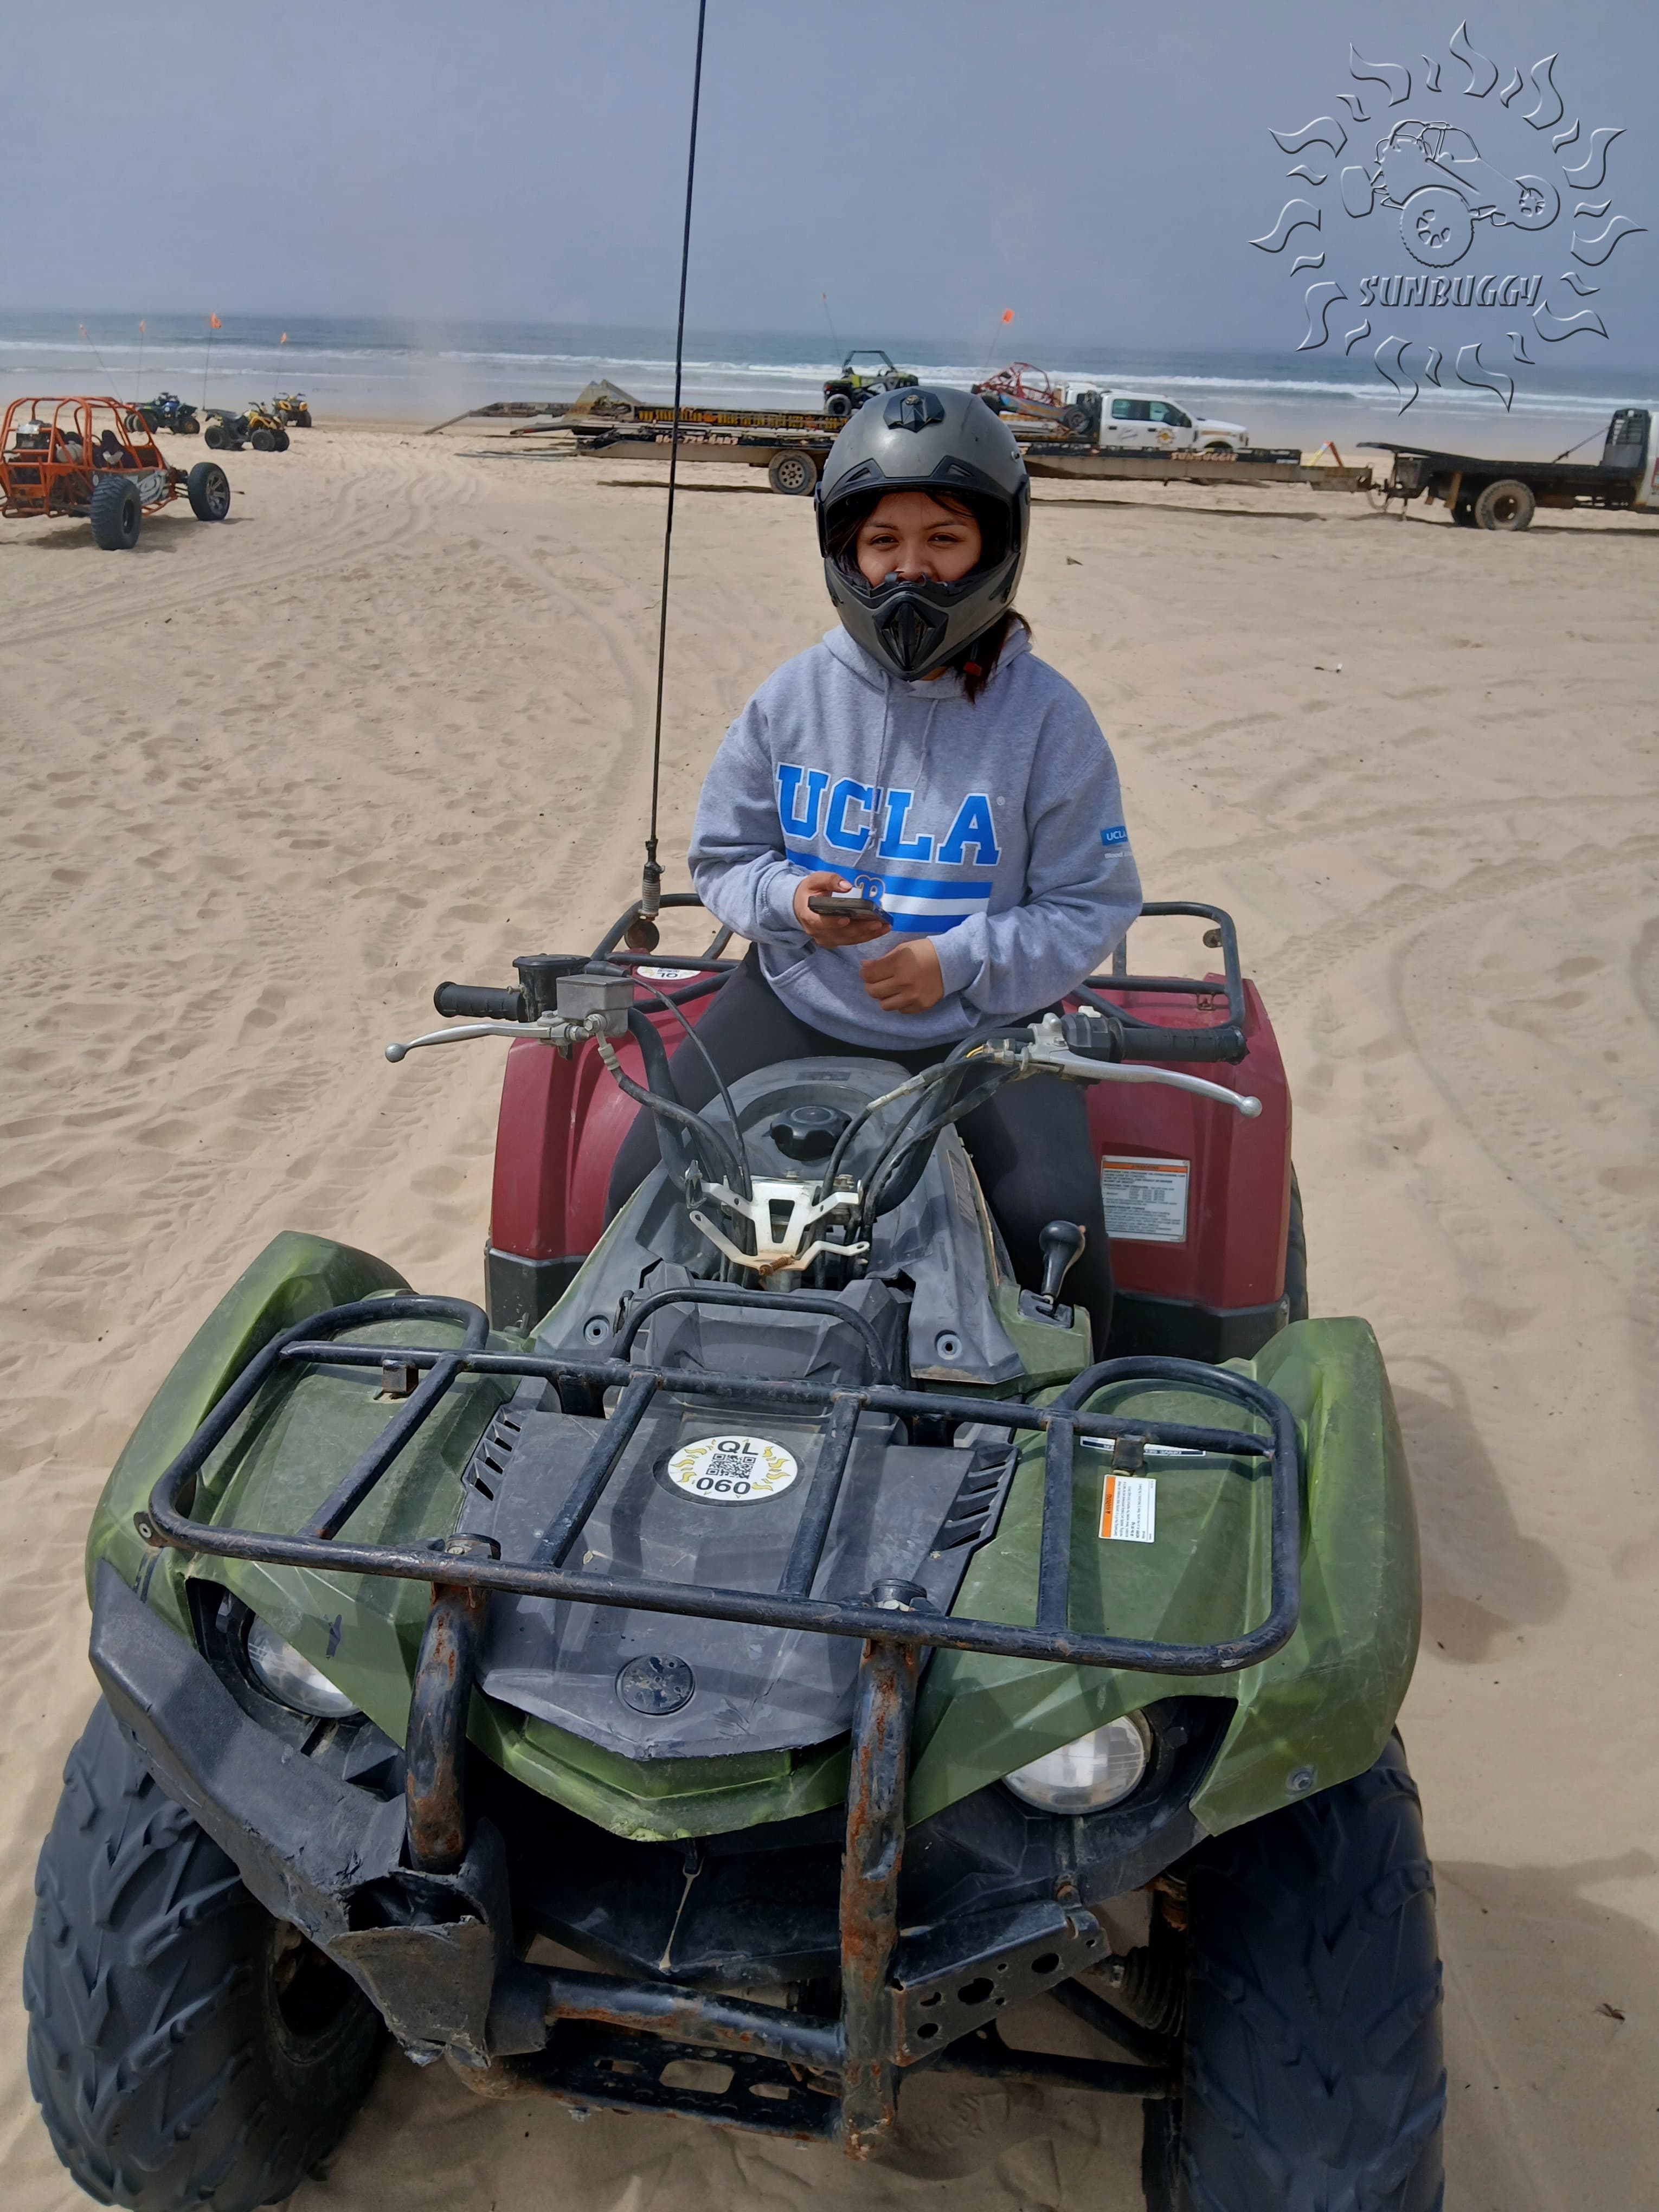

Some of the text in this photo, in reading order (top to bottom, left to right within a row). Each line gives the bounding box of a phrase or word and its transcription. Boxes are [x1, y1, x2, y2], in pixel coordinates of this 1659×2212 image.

[776, 762, 1001, 866] UCLA
[717, 1440, 759, 1455] QL
[696, 1477, 751, 1495] 060
